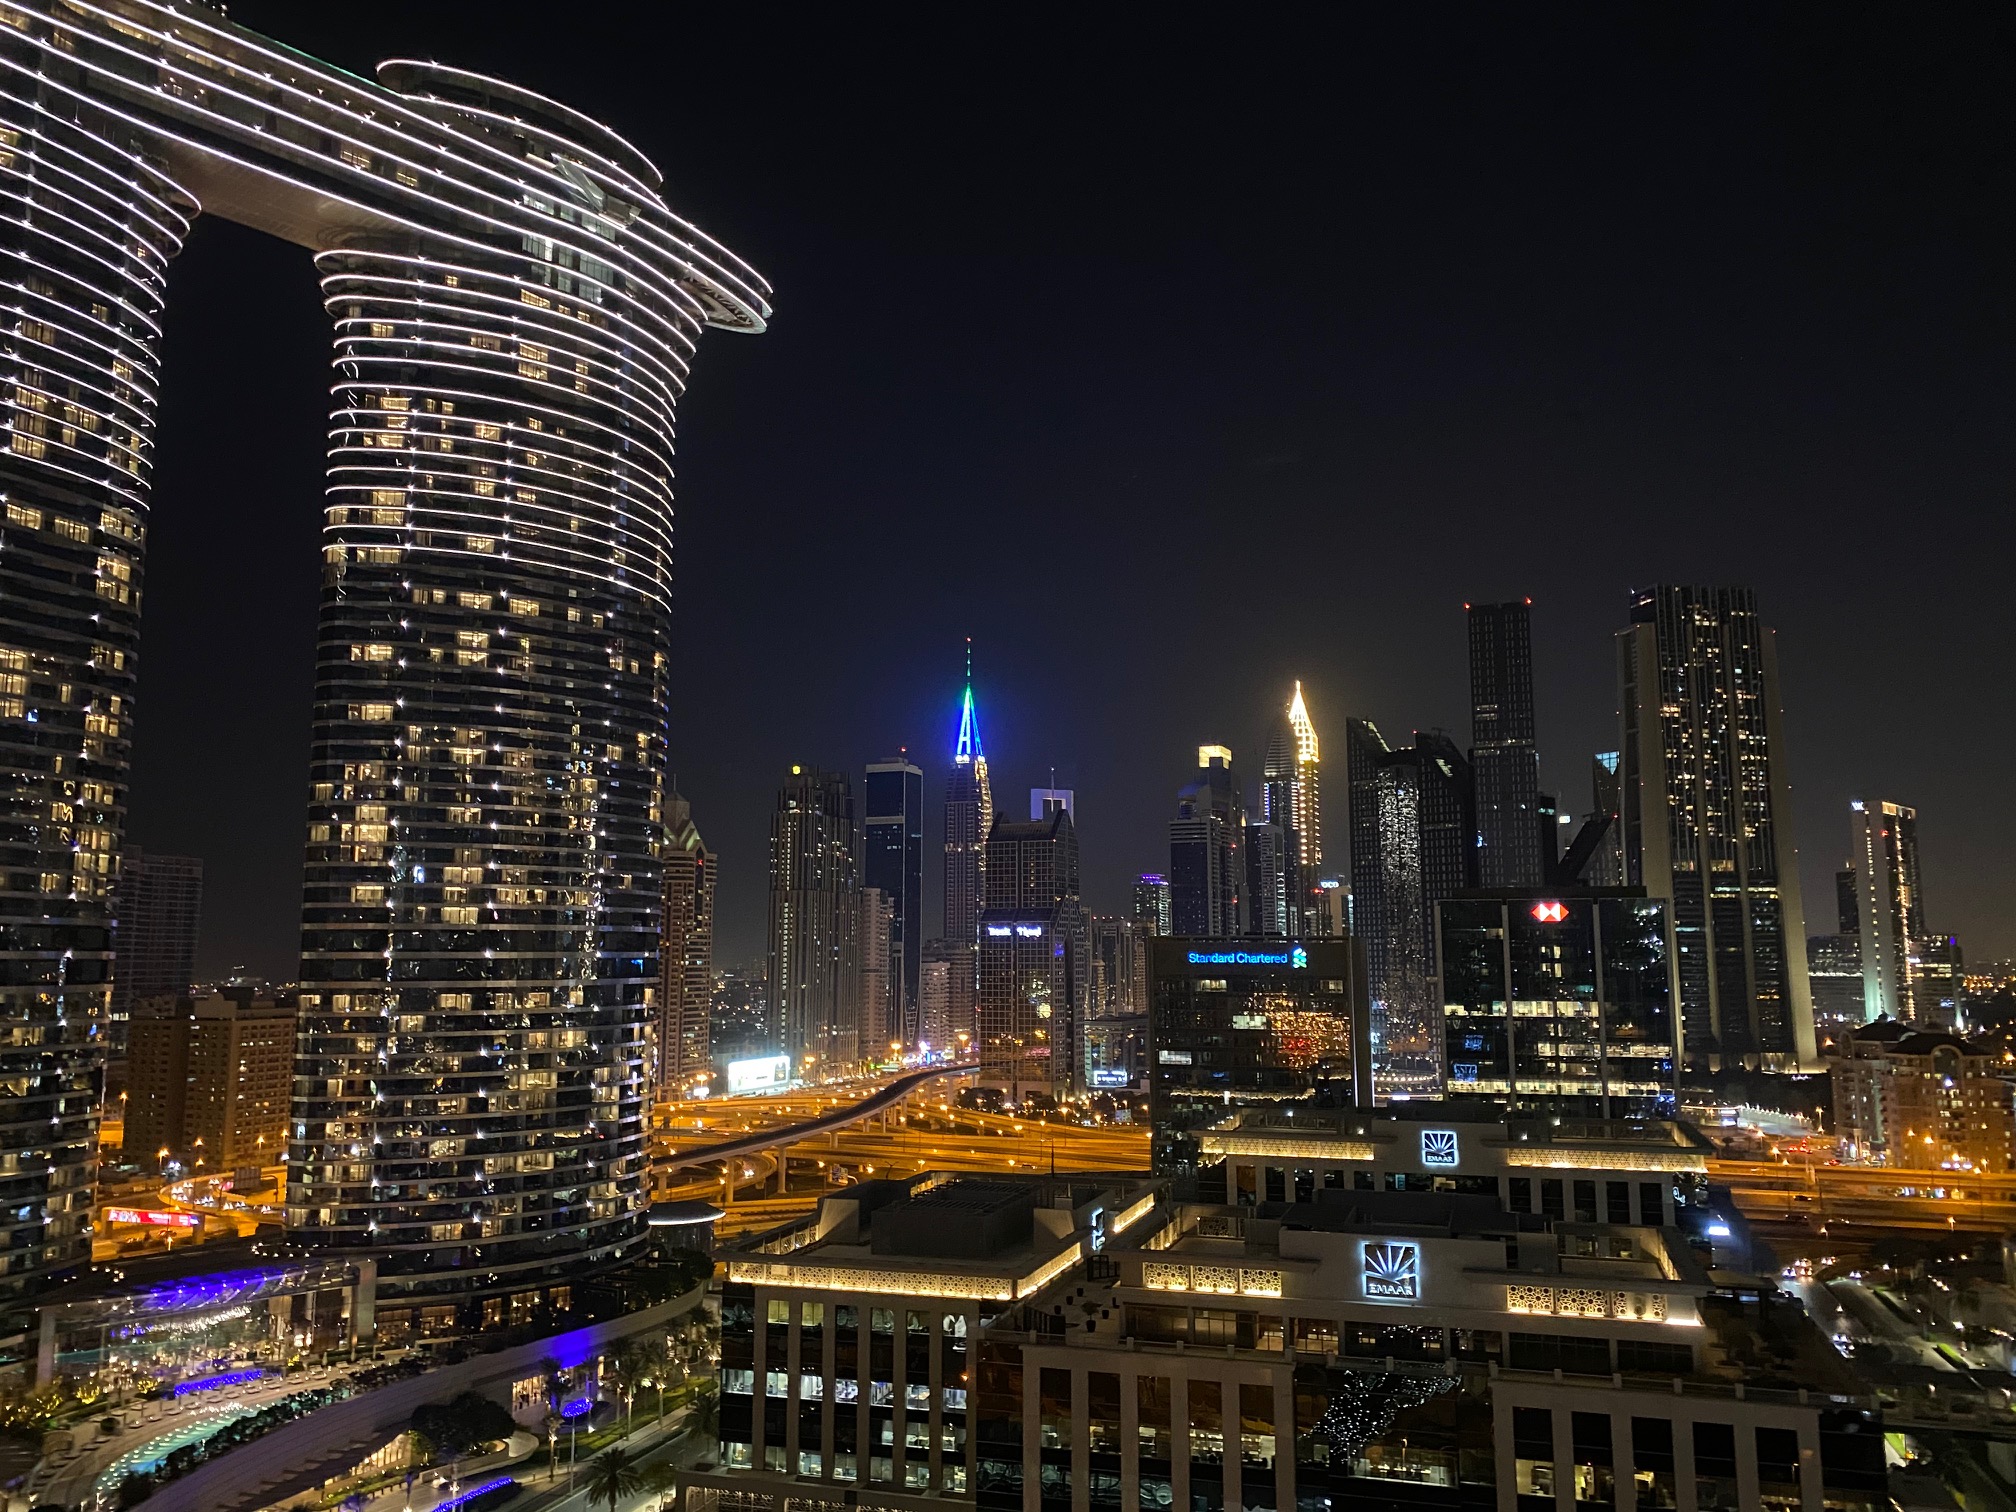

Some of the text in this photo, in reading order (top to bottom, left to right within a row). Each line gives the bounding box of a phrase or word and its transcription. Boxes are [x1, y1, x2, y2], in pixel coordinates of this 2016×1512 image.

[1188, 952, 1288, 964] Standard Chartered
[1427, 1155, 1454, 1163] EMAAR
[1368, 1283, 1414, 1296] EMAAR
